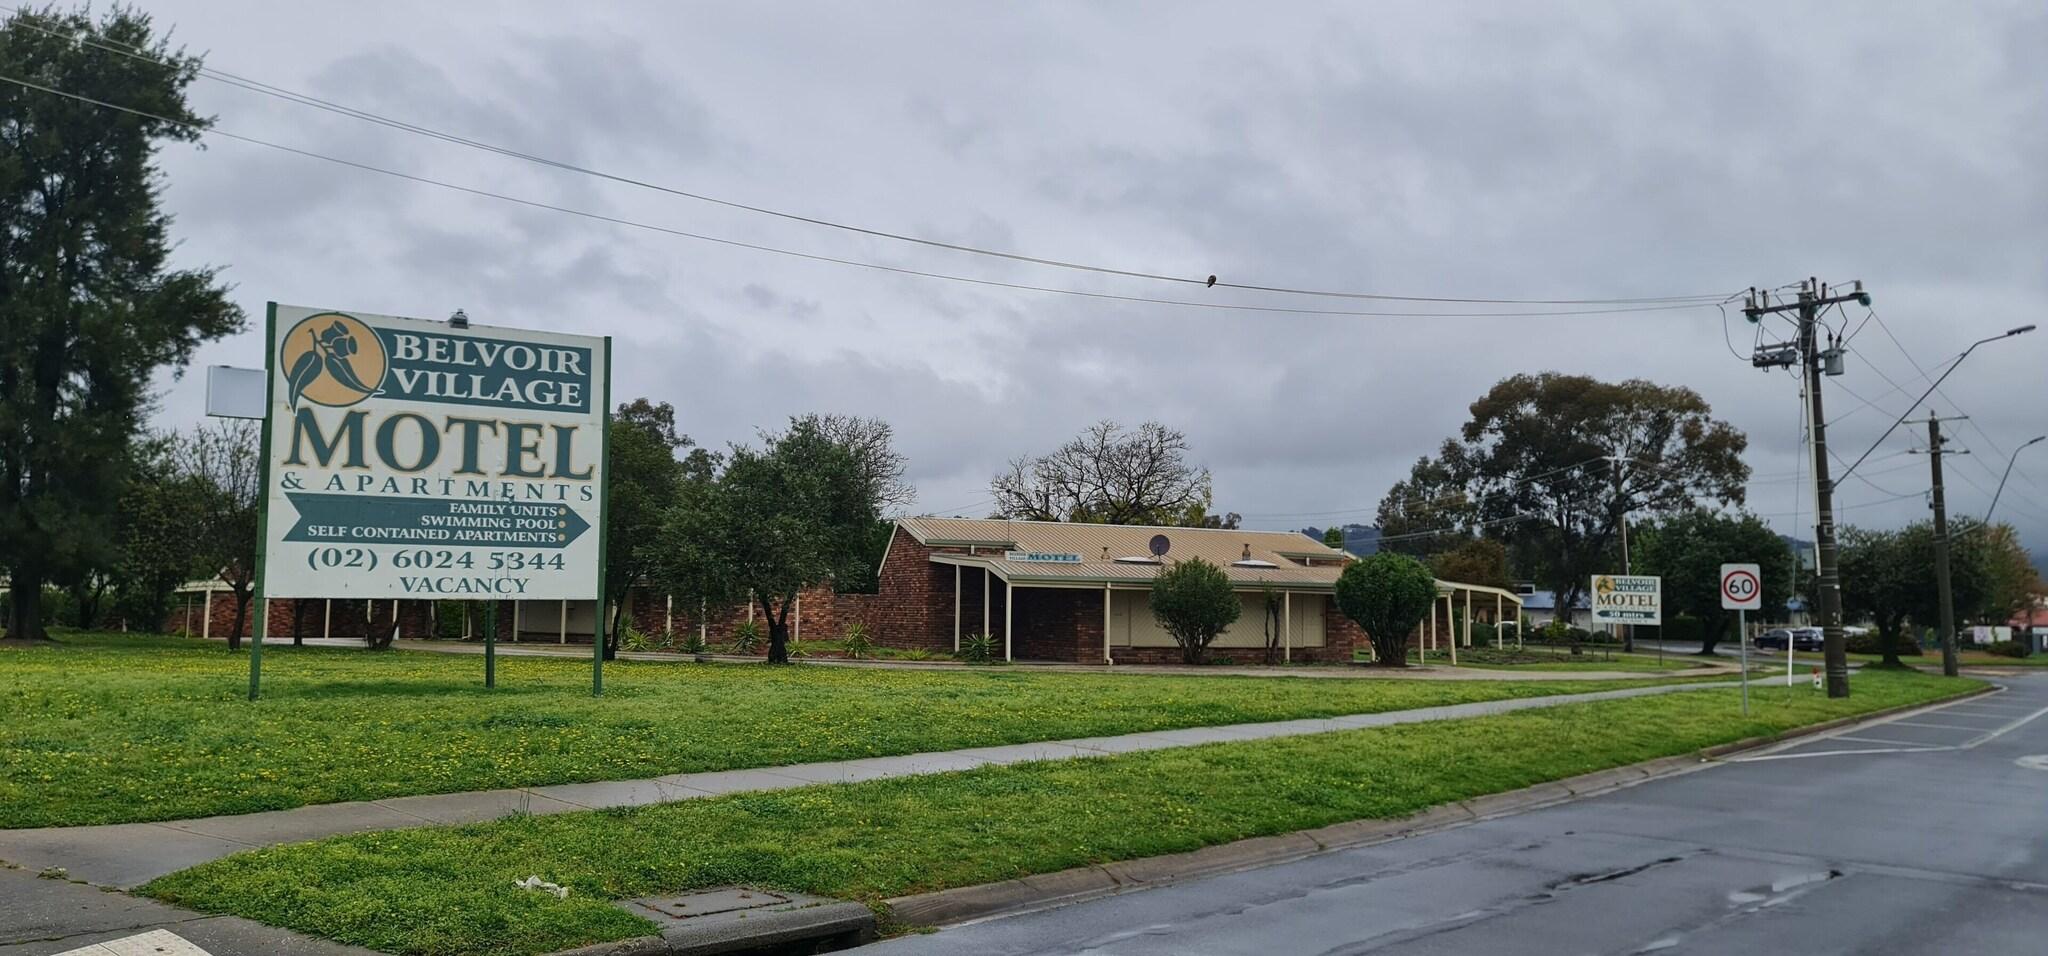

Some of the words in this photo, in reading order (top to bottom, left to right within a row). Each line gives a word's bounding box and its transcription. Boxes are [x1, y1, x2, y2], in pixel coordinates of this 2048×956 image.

[392, 333, 586, 376] BELVOIR
[391, 367, 583, 407] VILLAGE
[283, 407, 595, 481] MOTEL
[281, 471, 306, 490] &
[325, 473, 593, 502] APARTMENTS
[450, 502, 507, 516] FAMILY
[509, 505, 558, 518] UNITS
[421, 515, 511, 529] SWIMMING
[515, 517, 557, 530] POOL
[308, 525, 347, 537] SELF
[351, 525, 450, 540] CONTAINED
[453, 529, 557, 543] APARTMENTS
[307, 547, 379, 571] (02)
[392, 549, 475, 570] 6024
[486, 551, 566, 571] 5344
[399, 576, 530, 594] VACANCY
[1729, 579, 1754, 594] 60
[1597, 594, 1657, 606] MOTEL
